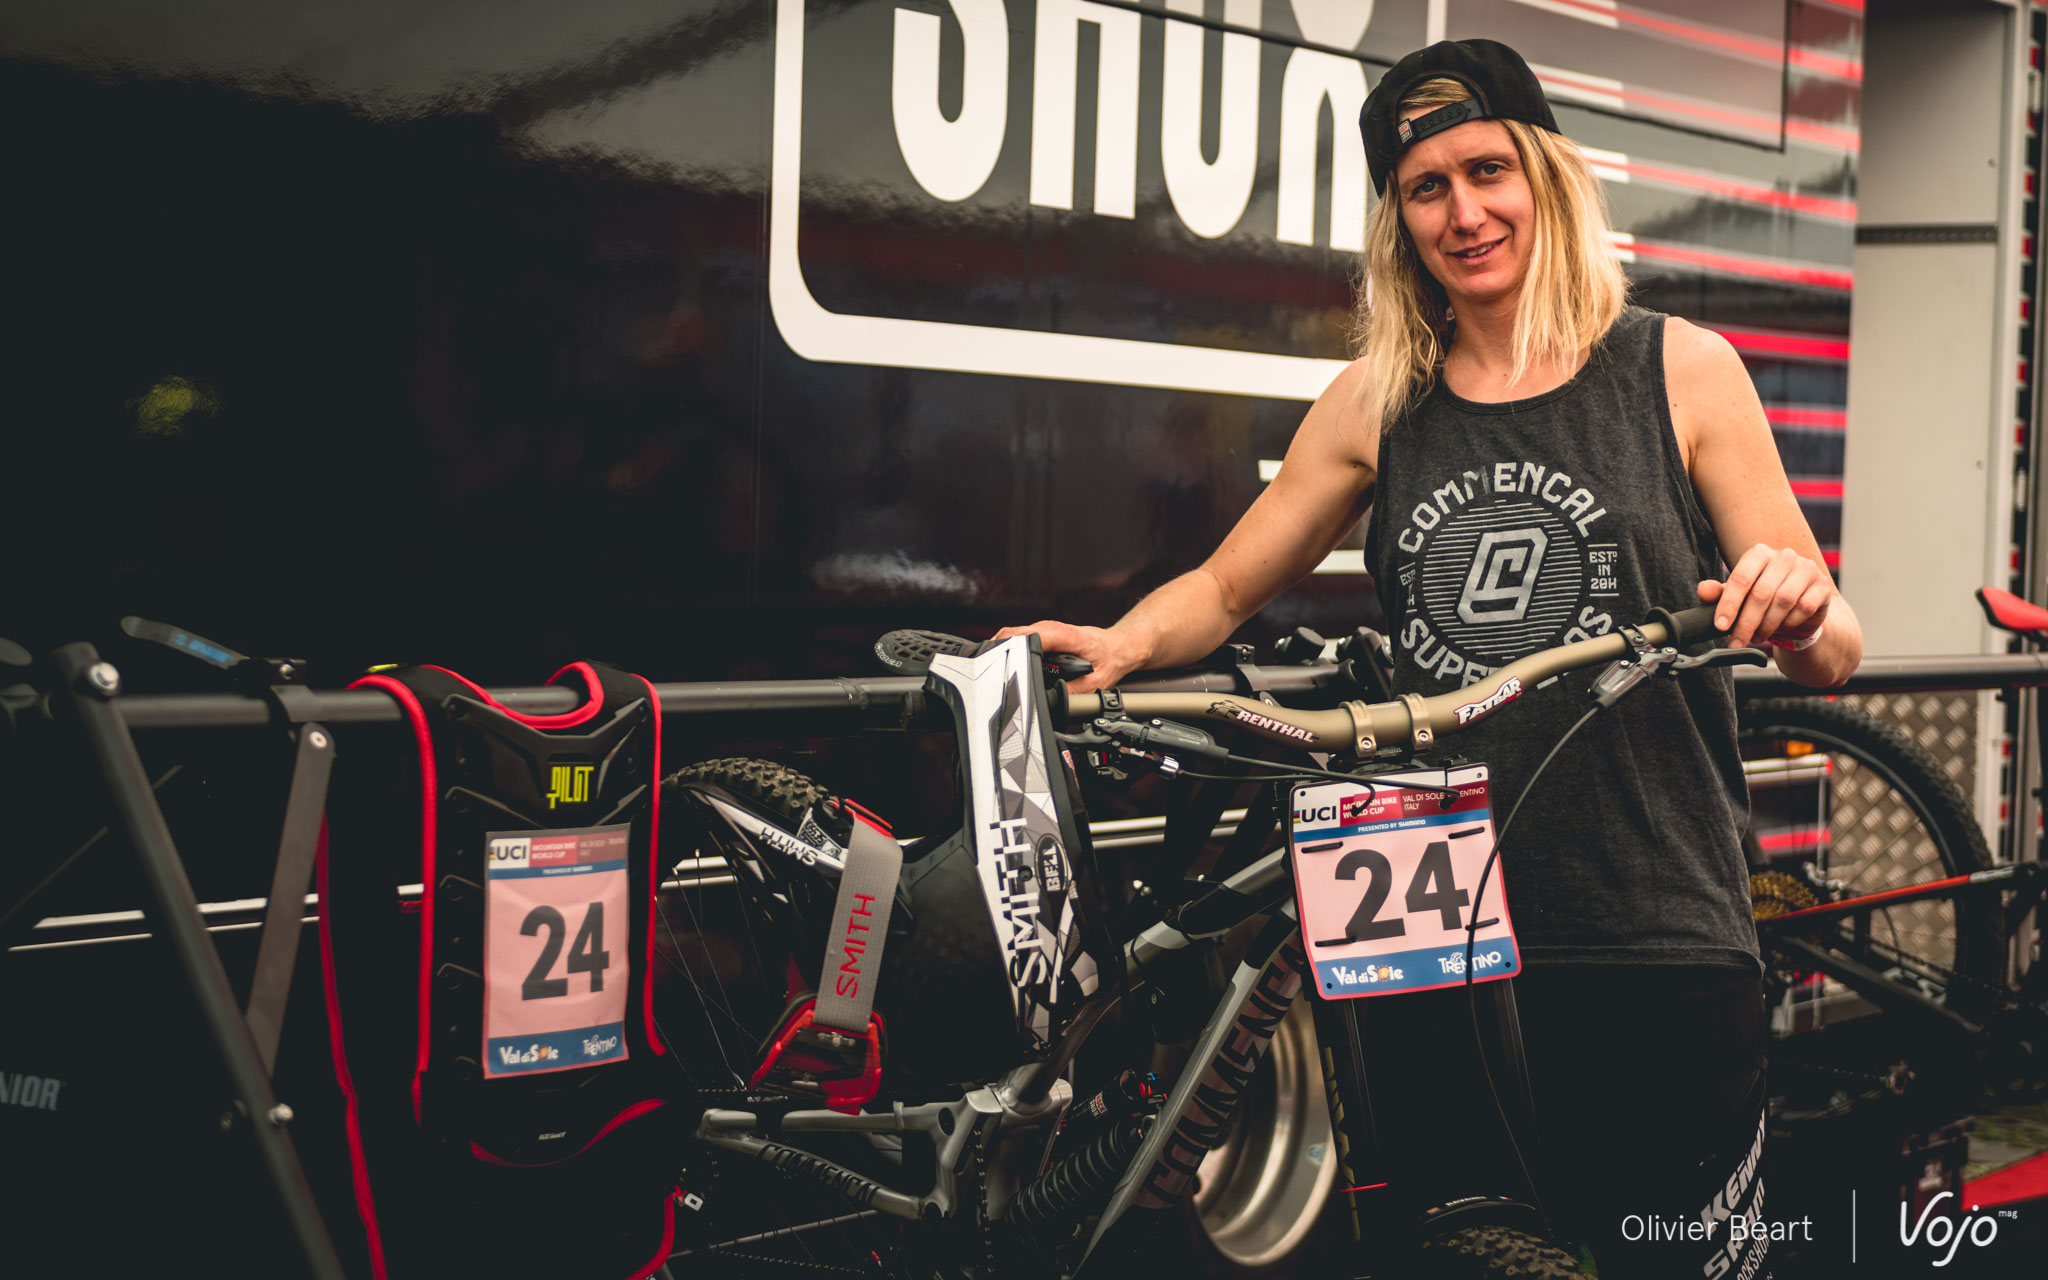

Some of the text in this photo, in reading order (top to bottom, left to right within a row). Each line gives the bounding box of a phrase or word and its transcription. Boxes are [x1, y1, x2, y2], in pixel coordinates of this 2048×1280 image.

[1398, 462, 1606, 553] COMMENCAL
[1598, 564, 1611, 576] IN
[1235, 710, 1318, 743] RENTHAL
[1382, 796, 1398, 805] BIKE
[1402, 794, 1415, 803] VAL
[1416, 793, 1425, 801] DI
[1425, 792, 1445, 801] SOLE
[1301, 806, 1337, 823] UCI
[1369, 806, 1385, 816] CUP
[1404, 802, 1420, 811] ITALY
[1358, 823, 1389, 832] PRESENTED
[1390, 822, 1397, 830] BY
[496, 845, 527, 861] UCI
[1335, 841, 1470, 942] 24
[989, 817, 1048, 988] SMITH
[520, 901, 610, 1001] 24
[836, 893, 876, 999] SMITH
